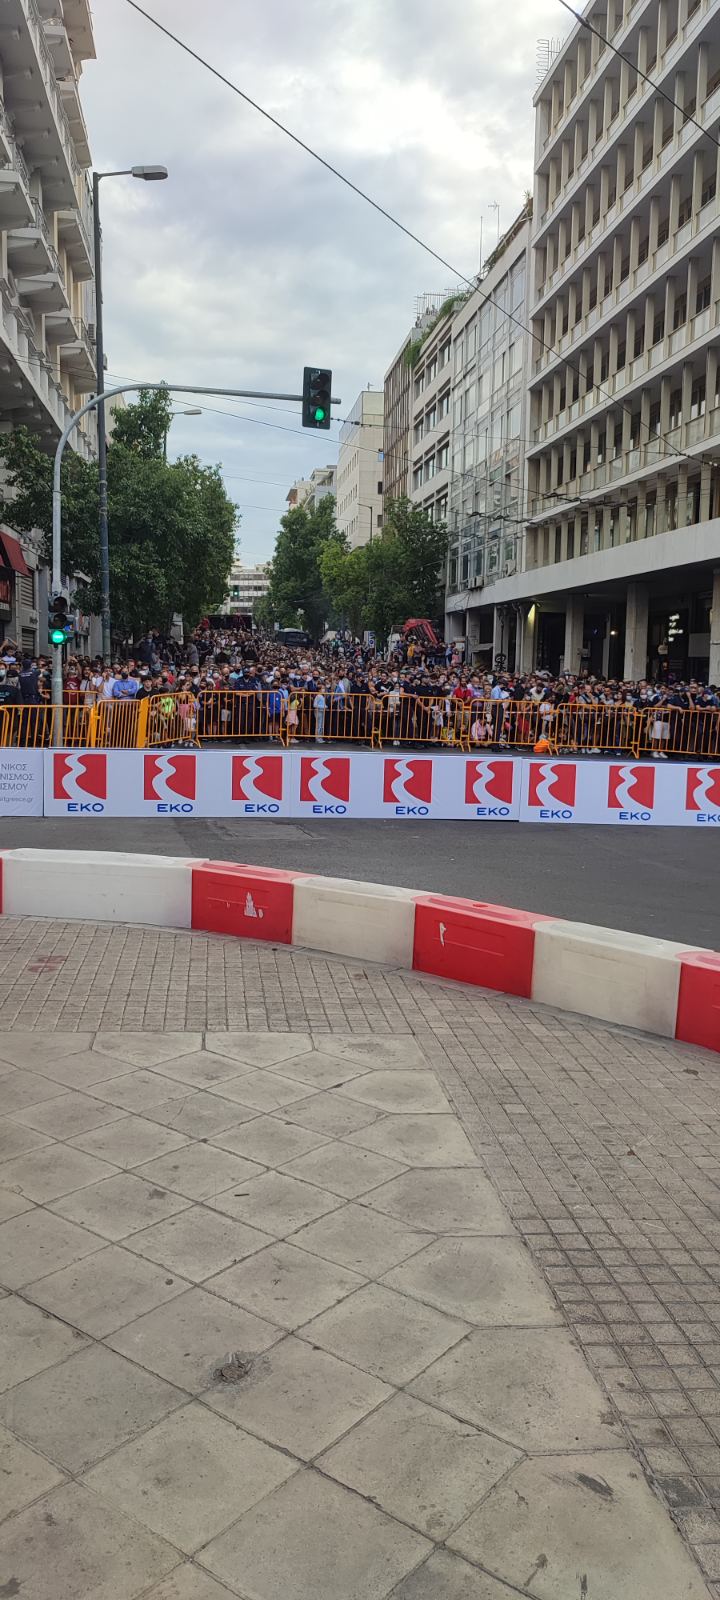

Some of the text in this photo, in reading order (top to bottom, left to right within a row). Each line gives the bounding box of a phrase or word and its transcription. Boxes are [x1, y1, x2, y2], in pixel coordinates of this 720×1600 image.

[67, 802, 104, 813] EKO
[157, 802, 193, 813] EKO
[245, 803, 279, 814] EKO
[313, 804, 347, 815] EKO
[396, 805, 429, 816] EKO
[477, 806, 510, 817] EKO
[540, 809, 572, 820] EKO
[619, 811, 651, 822] EKO
[697, 813, 720, 822] EK
